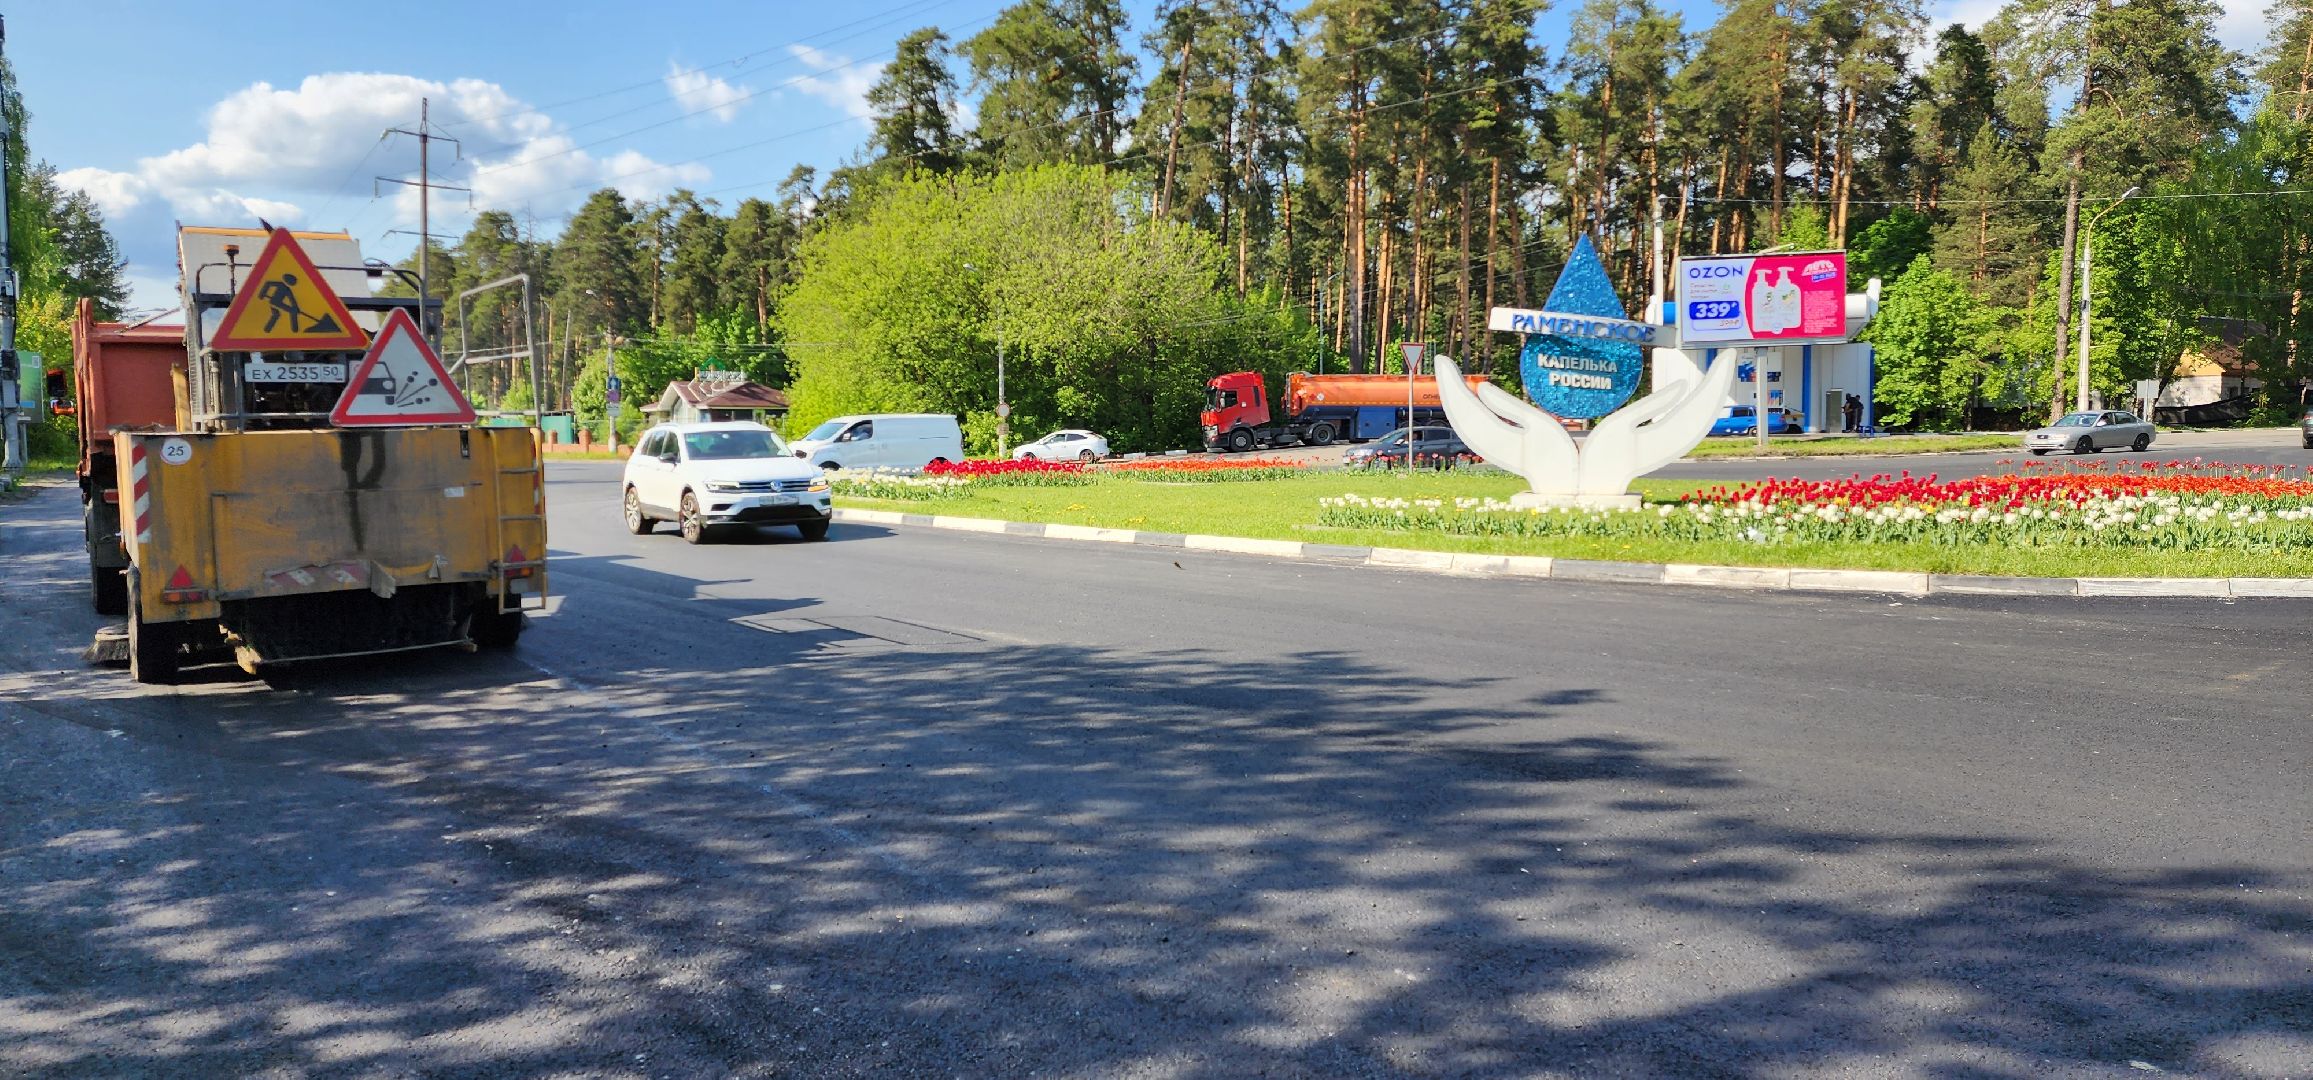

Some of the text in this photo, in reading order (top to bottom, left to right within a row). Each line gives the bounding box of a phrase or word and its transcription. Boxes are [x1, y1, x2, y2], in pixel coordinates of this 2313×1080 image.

[1690, 266, 1743, 279] OZON
[1511, 313, 1657, 342] РАМЕНСКОЕ
[1537, 353, 1618, 373] КАПЕЛЬКА
[277, 366, 319, 380] 2535
[322, 366, 339, 376] 50
[1550, 371, 1612, 390] РОССИИ
[167, 445, 184, 457] 25
